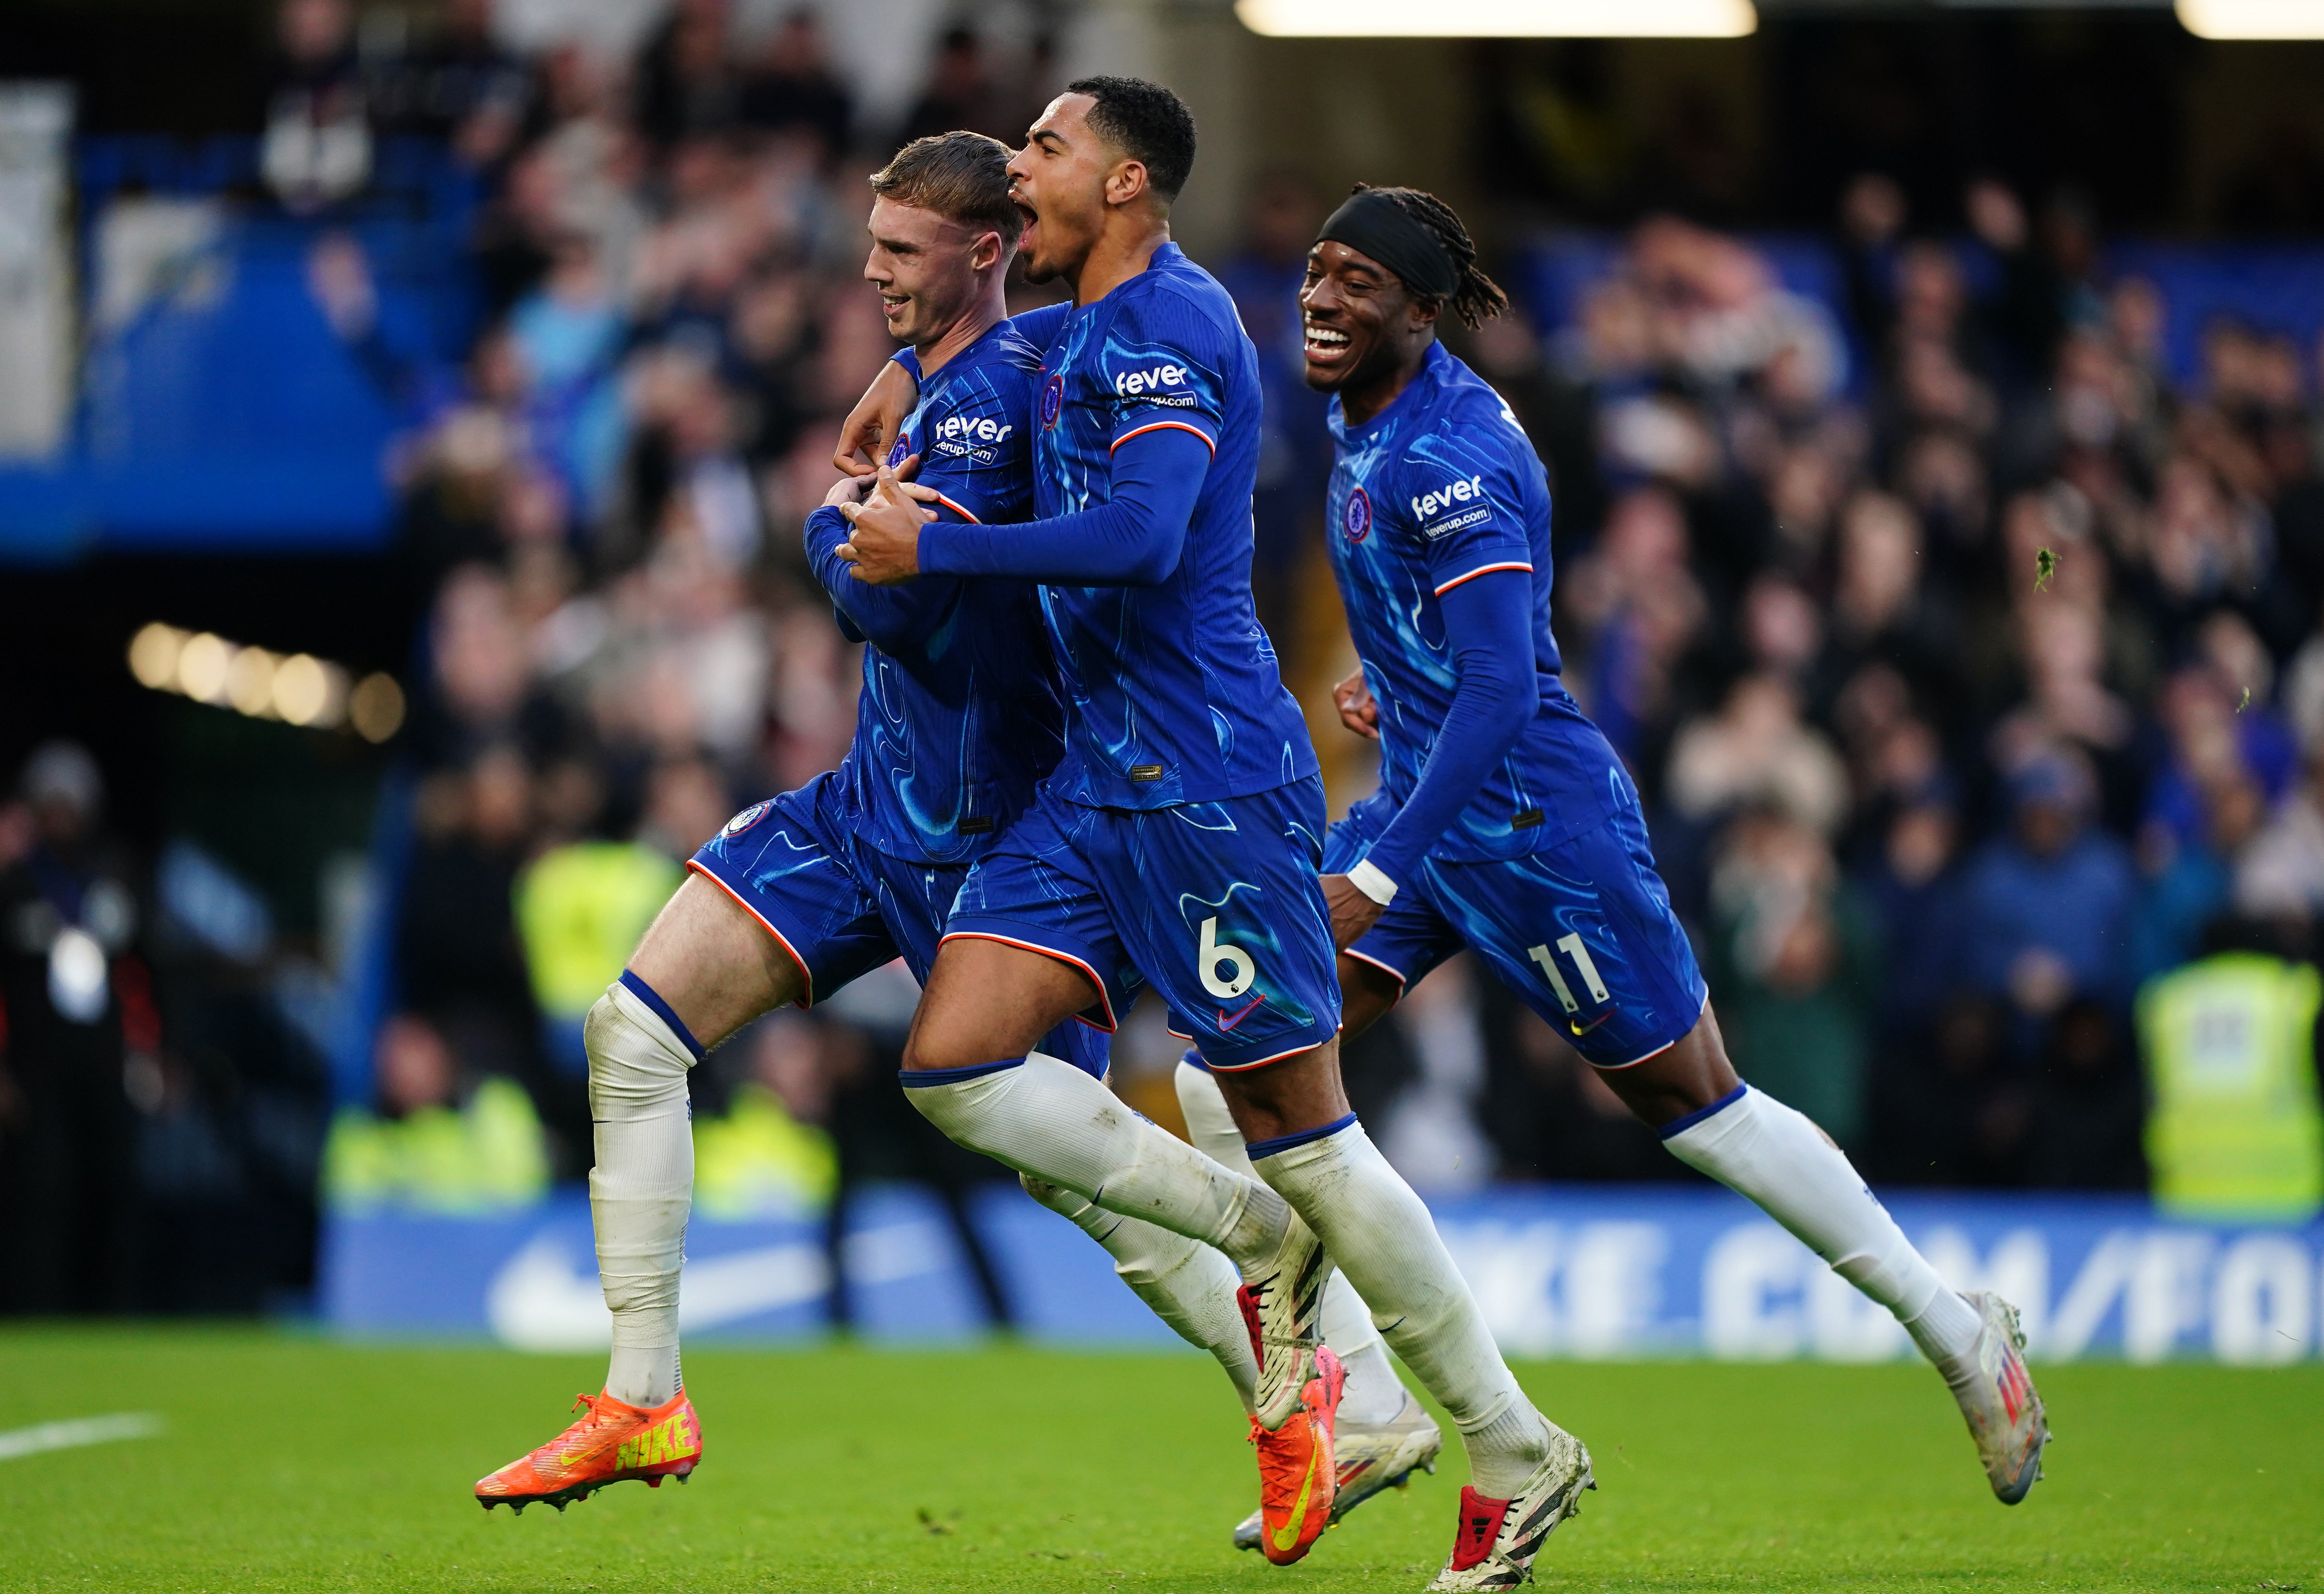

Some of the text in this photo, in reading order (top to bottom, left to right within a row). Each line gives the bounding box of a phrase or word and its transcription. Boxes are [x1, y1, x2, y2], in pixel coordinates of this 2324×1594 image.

[1116, 365, 1187, 397] fever
[1130, 395, 1194, 406] up.com
[936, 417, 1012, 442] fever
[936, 441, 992, 460] erup.om
[1412, 475, 1481, 522] fever
[1199, 916, 1256, 999] 6
[1527, 931, 1610, 1013] 11
[614, 1411, 695, 1472] NIKE
